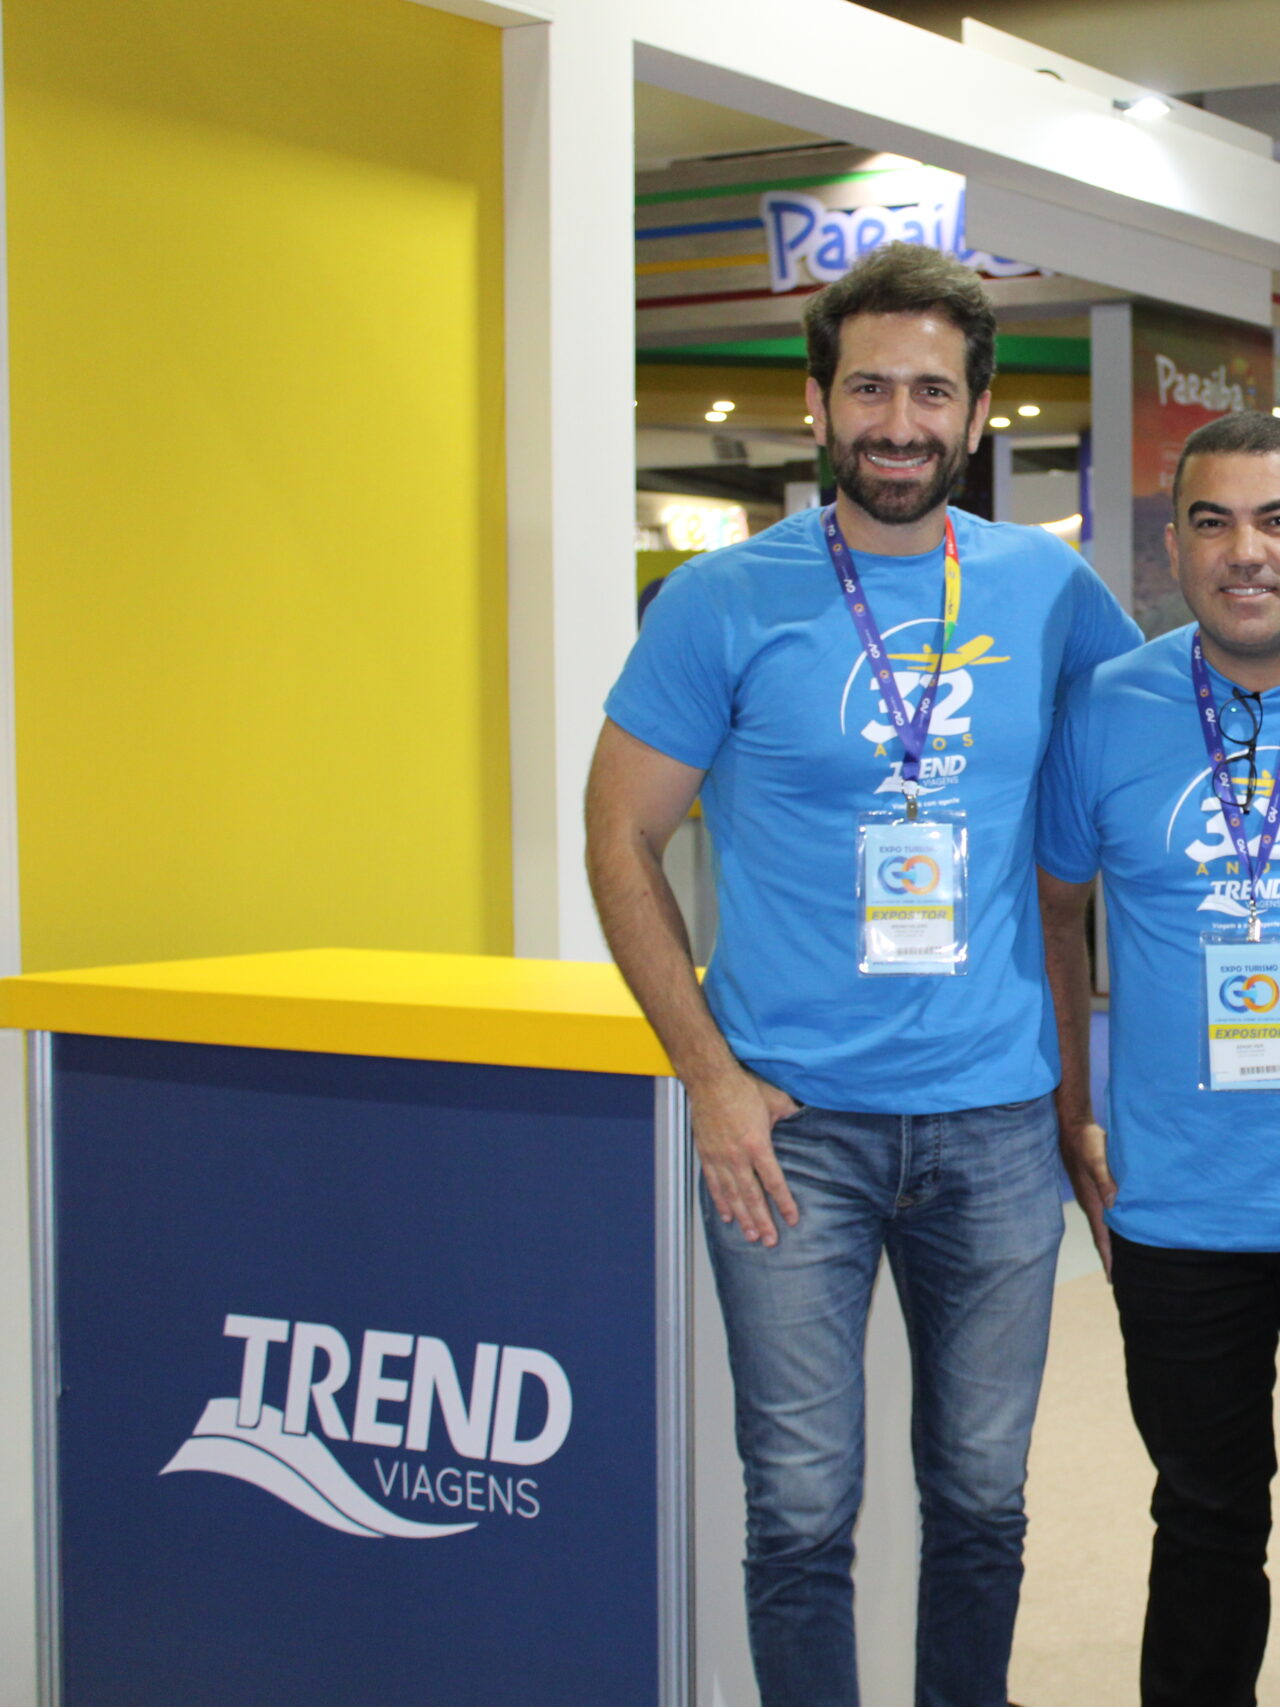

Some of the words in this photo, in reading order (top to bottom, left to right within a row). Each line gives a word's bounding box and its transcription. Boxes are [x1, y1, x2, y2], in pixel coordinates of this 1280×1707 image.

[860, 668, 974, 744] 32
[873, 733, 975, 758] AOS
[889, 754, 967, 780] TEND
[1220, 965, 1242, 973] EXPO
[1244, 964, 1279, 972] TURISMO
[223, 1313, 573, 1466] TREND
[373, 1457, 541, 1519] VIAGENS
